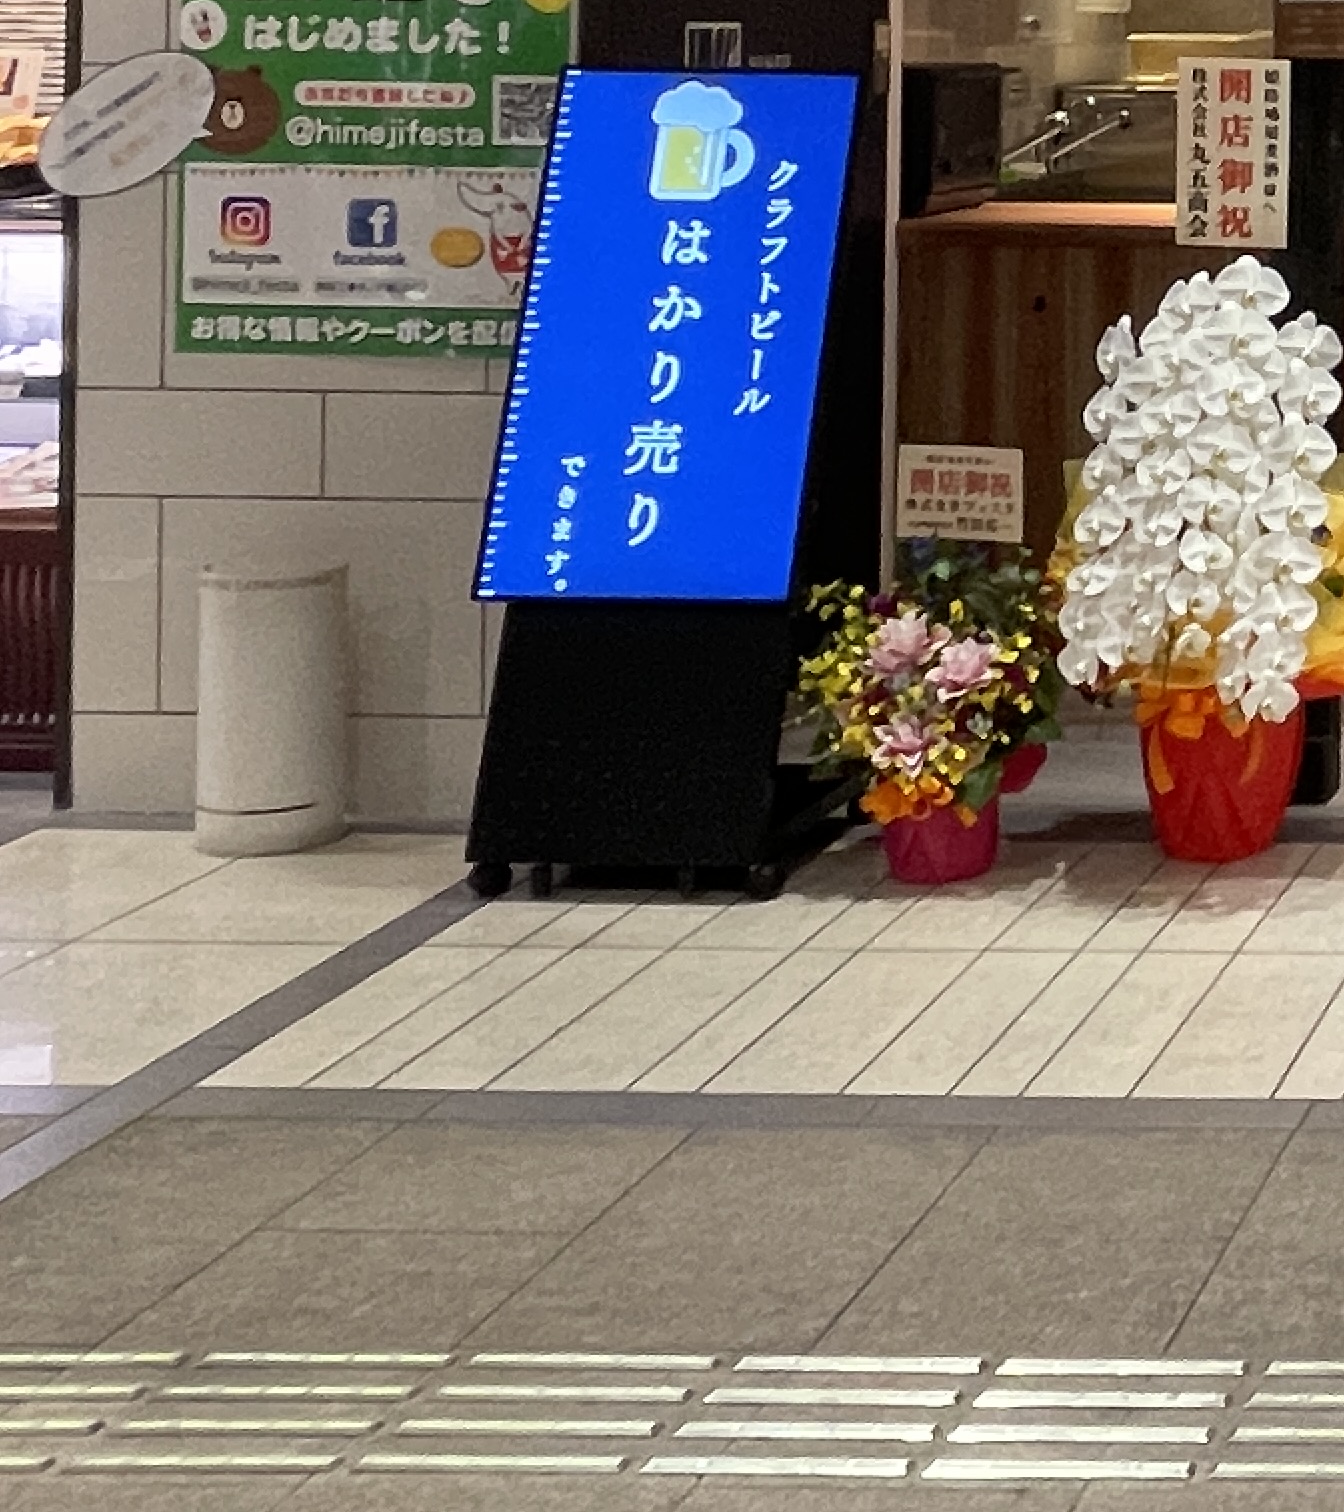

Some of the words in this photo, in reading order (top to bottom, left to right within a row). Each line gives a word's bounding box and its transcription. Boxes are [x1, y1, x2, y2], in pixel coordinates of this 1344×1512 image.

[243, 14, 511, 56] はじめました！
[284, 116, 485, 149] @himejifesta
[1216, 67, 1255, 238] 開店御祝
[733, 159, 799, 416] クラフトビール
[622, 219, 712, 547] はかり売り
[544, 453, 588, 592] できます。
